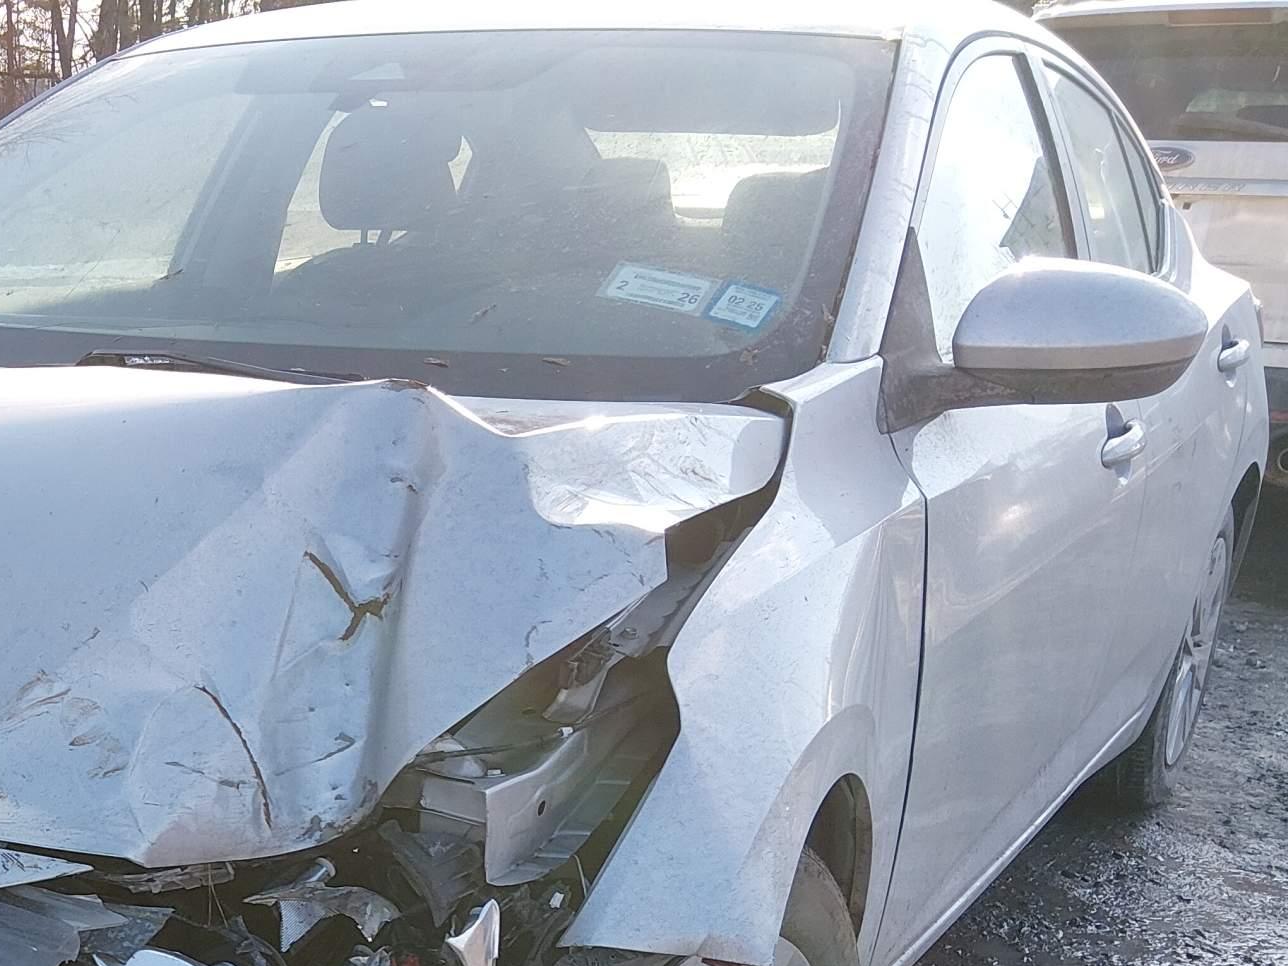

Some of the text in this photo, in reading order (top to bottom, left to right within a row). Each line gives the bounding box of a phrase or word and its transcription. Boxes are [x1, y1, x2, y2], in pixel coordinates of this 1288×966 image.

[616, 280, 629, 291] 2
[678, 292, 700, 305] 26
[727, 295, 745, 305] 02
